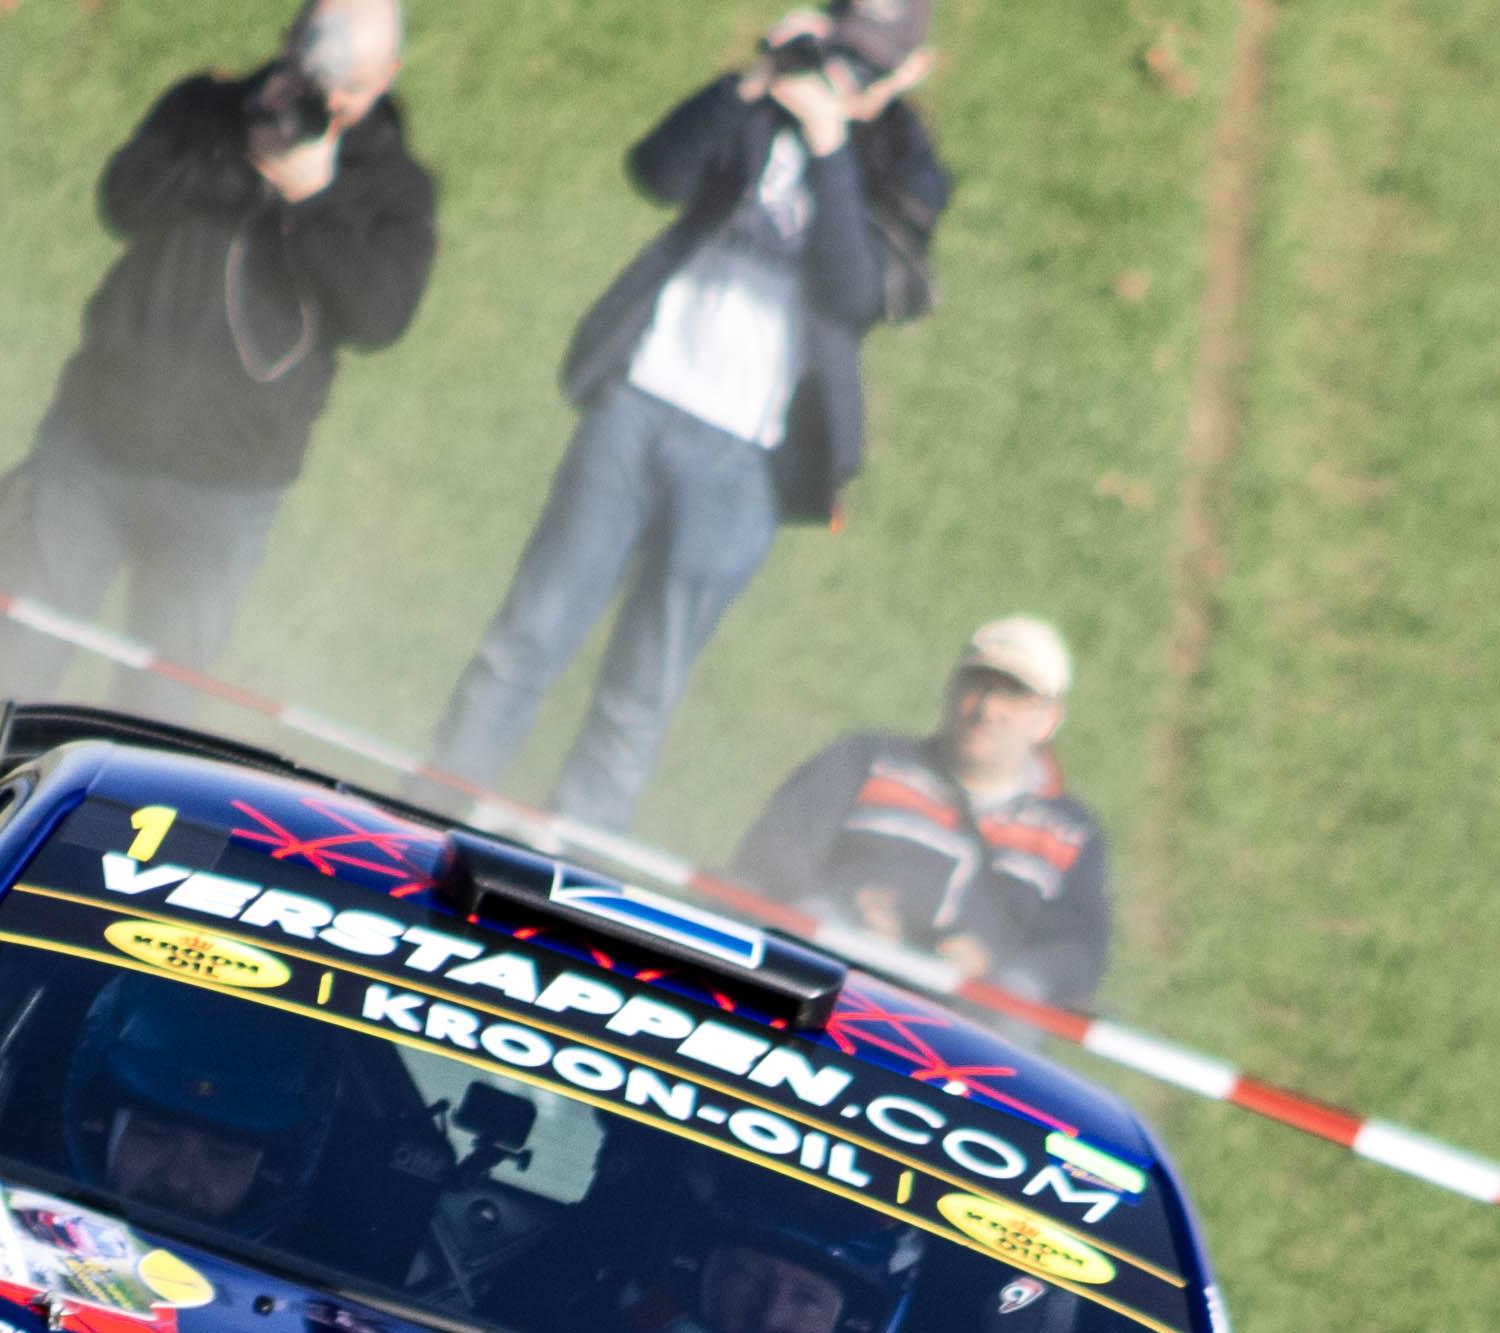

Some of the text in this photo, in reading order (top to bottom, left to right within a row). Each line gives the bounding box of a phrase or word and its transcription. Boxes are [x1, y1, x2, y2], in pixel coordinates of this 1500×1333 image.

[126, 806, 177, 862] 1
[101, 853, 1120, 1223] VERSTAPPEN.COM
[362, 984, 871, 1187] KROON-OIL
